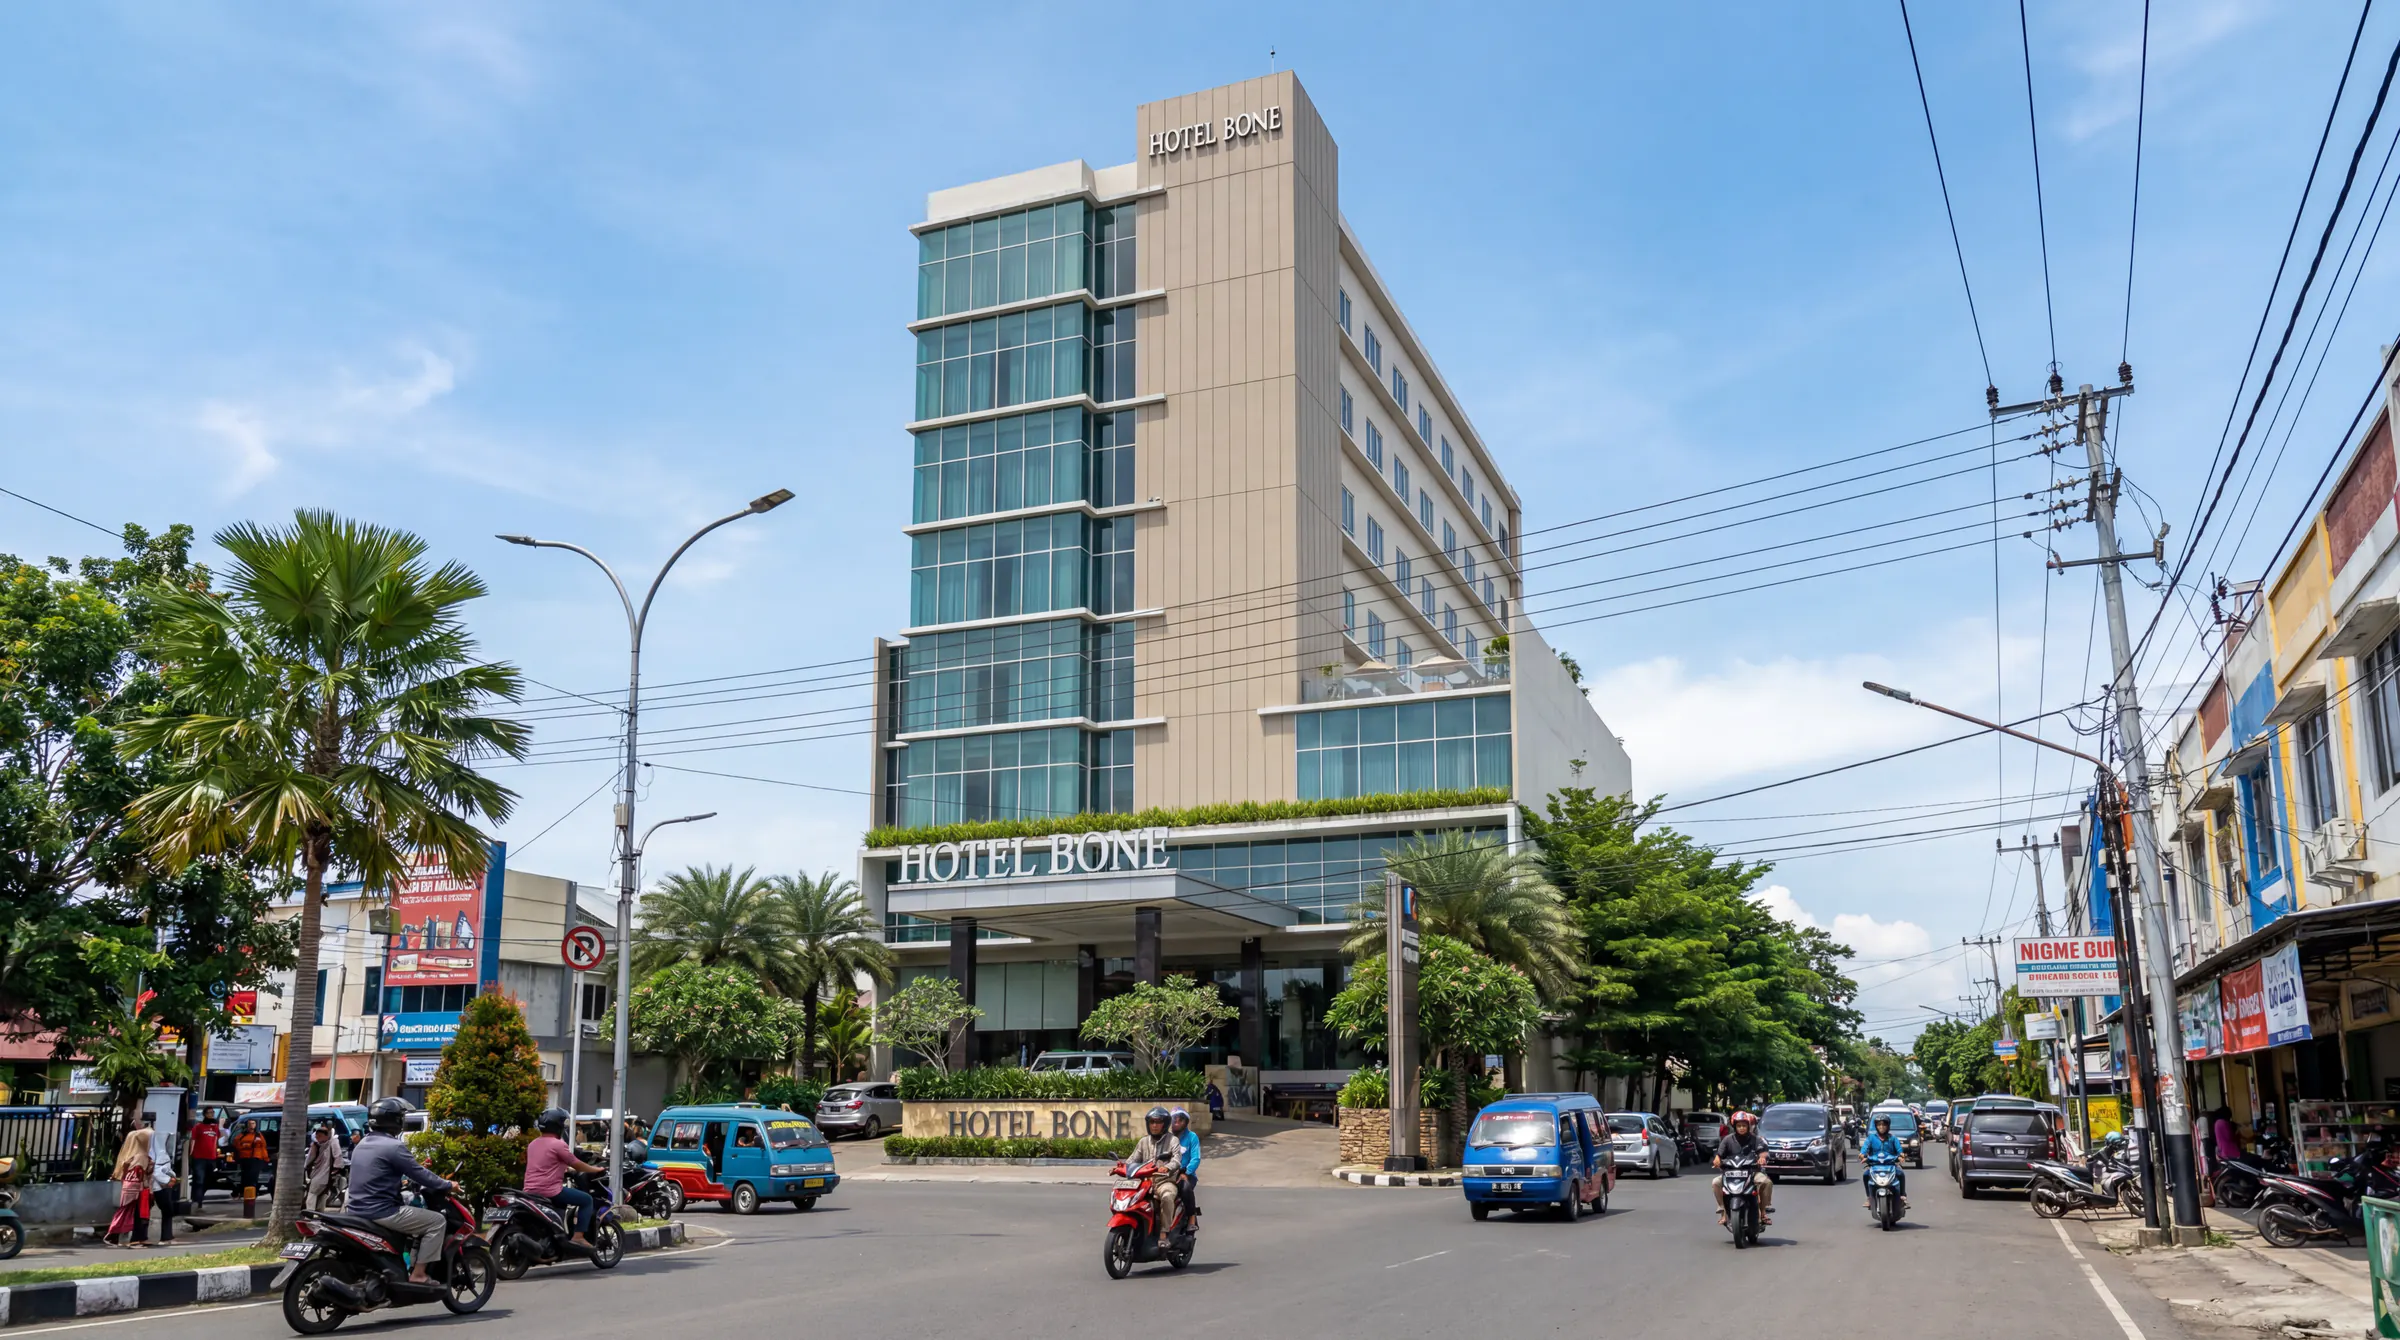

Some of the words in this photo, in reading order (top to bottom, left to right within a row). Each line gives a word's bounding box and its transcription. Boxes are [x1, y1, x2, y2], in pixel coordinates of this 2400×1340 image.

[1149, 122, 1217, 156] HOTEL
[1223, 106, 1281, 141] BONE
[898, 837, 1037, 883] HOTEL
[1048, 827, 1170, 875] BONE
[2021, 942, 2080, 961] NIGME
[948, 1110, 1042, 1139] HOTEL
[1050, 1110, 1132, 1140] BONE
